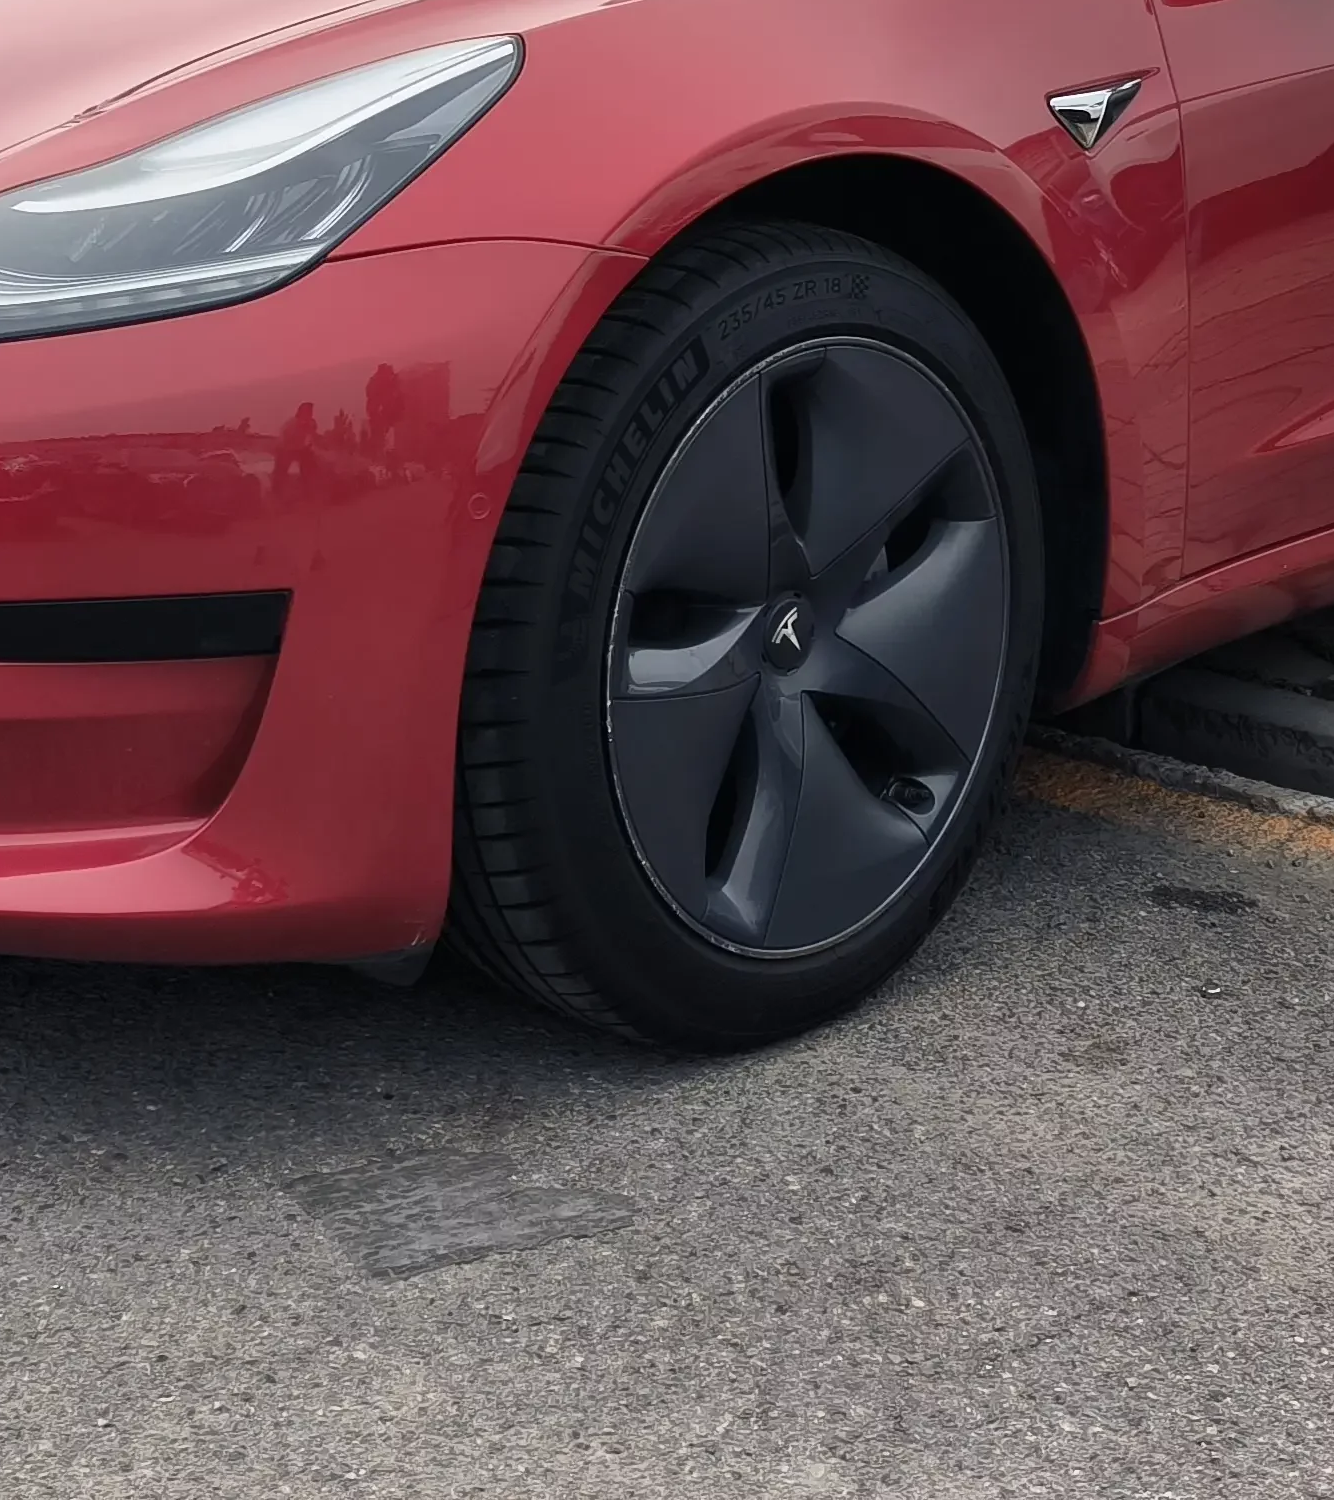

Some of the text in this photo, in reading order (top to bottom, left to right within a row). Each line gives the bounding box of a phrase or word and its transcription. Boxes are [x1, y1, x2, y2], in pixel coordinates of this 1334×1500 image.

[717, 287, 787, 342] 235/45
[792, 279, 817, 302] ZR
[824, 275, 843, 296] 18
[567, 342, 703, 602] MICHELIN
